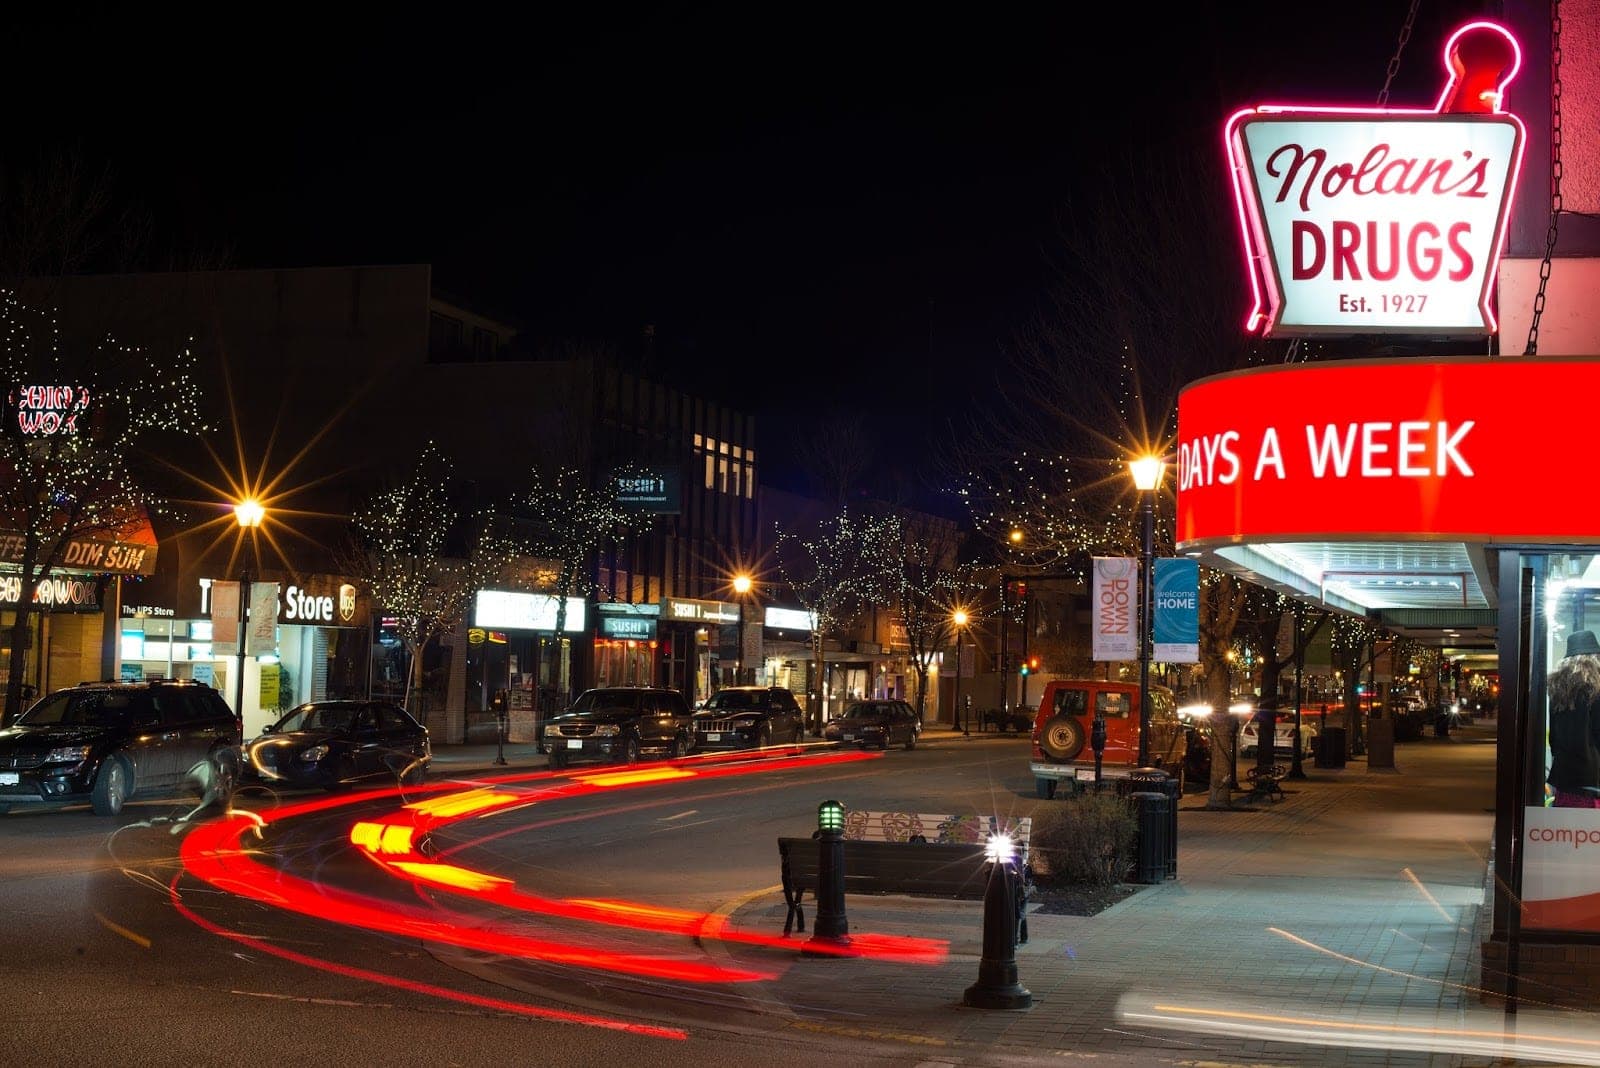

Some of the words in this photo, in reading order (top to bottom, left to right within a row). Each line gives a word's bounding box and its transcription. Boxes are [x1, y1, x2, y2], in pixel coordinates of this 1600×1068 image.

[1266, 142, 1490, 213] Nolan's
[1291, 220, 1475, 283] DRUGS
[1339, 294, 1372, 313] Est.
[1381, 294, 1428, 313] 1927
[1179, 430, 1240, 492] DAYS
[1253, 427, 1286, 481] A
[1306, 420, 1476, 478] WEEK
[64, 541, 105, 567] DIM
[104, 545, 146, 570] SUM
[55, 579, 97, 605] WOK
[286, 585, 334, 621] Store
[1157, 590, 1196, 598] welcome
[1157, 598, 1196, 609] HOME
[122, 605, 136, 615] The
[137, 605, 153, 616] UPS
[154, 606, 174, 617] Store
[1101, 580, 1115, 635] TOWN
[1115, 579, 1129, 635] DOWN
[612, 621, 641, 632] SUSHI
[1529, 828, 1600, 849] compo
